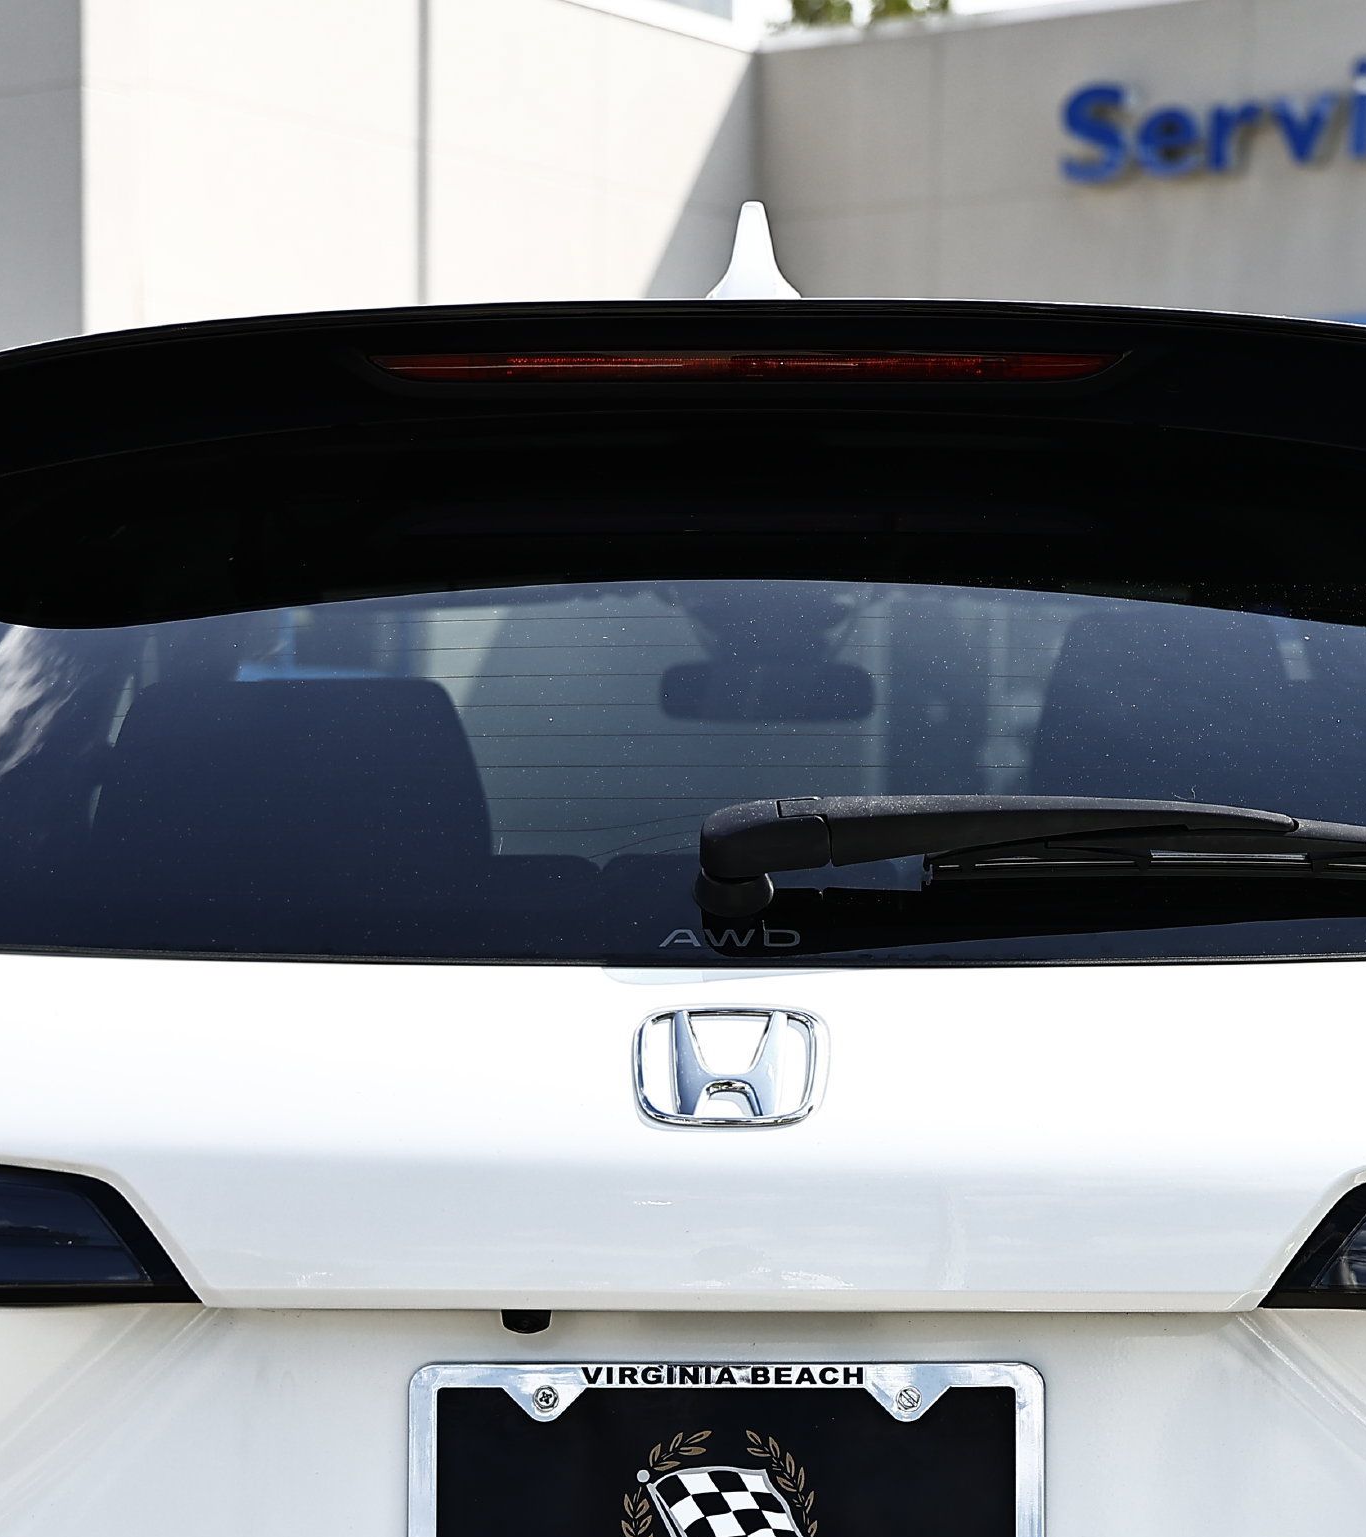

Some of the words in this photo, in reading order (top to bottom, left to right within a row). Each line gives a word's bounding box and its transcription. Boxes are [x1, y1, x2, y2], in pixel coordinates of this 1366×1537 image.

[659, 929, 801, 947] AWD
[581, 1366, 736, 1385] VIRGINIA
[752, 1366, 865, 1385] BEACH
